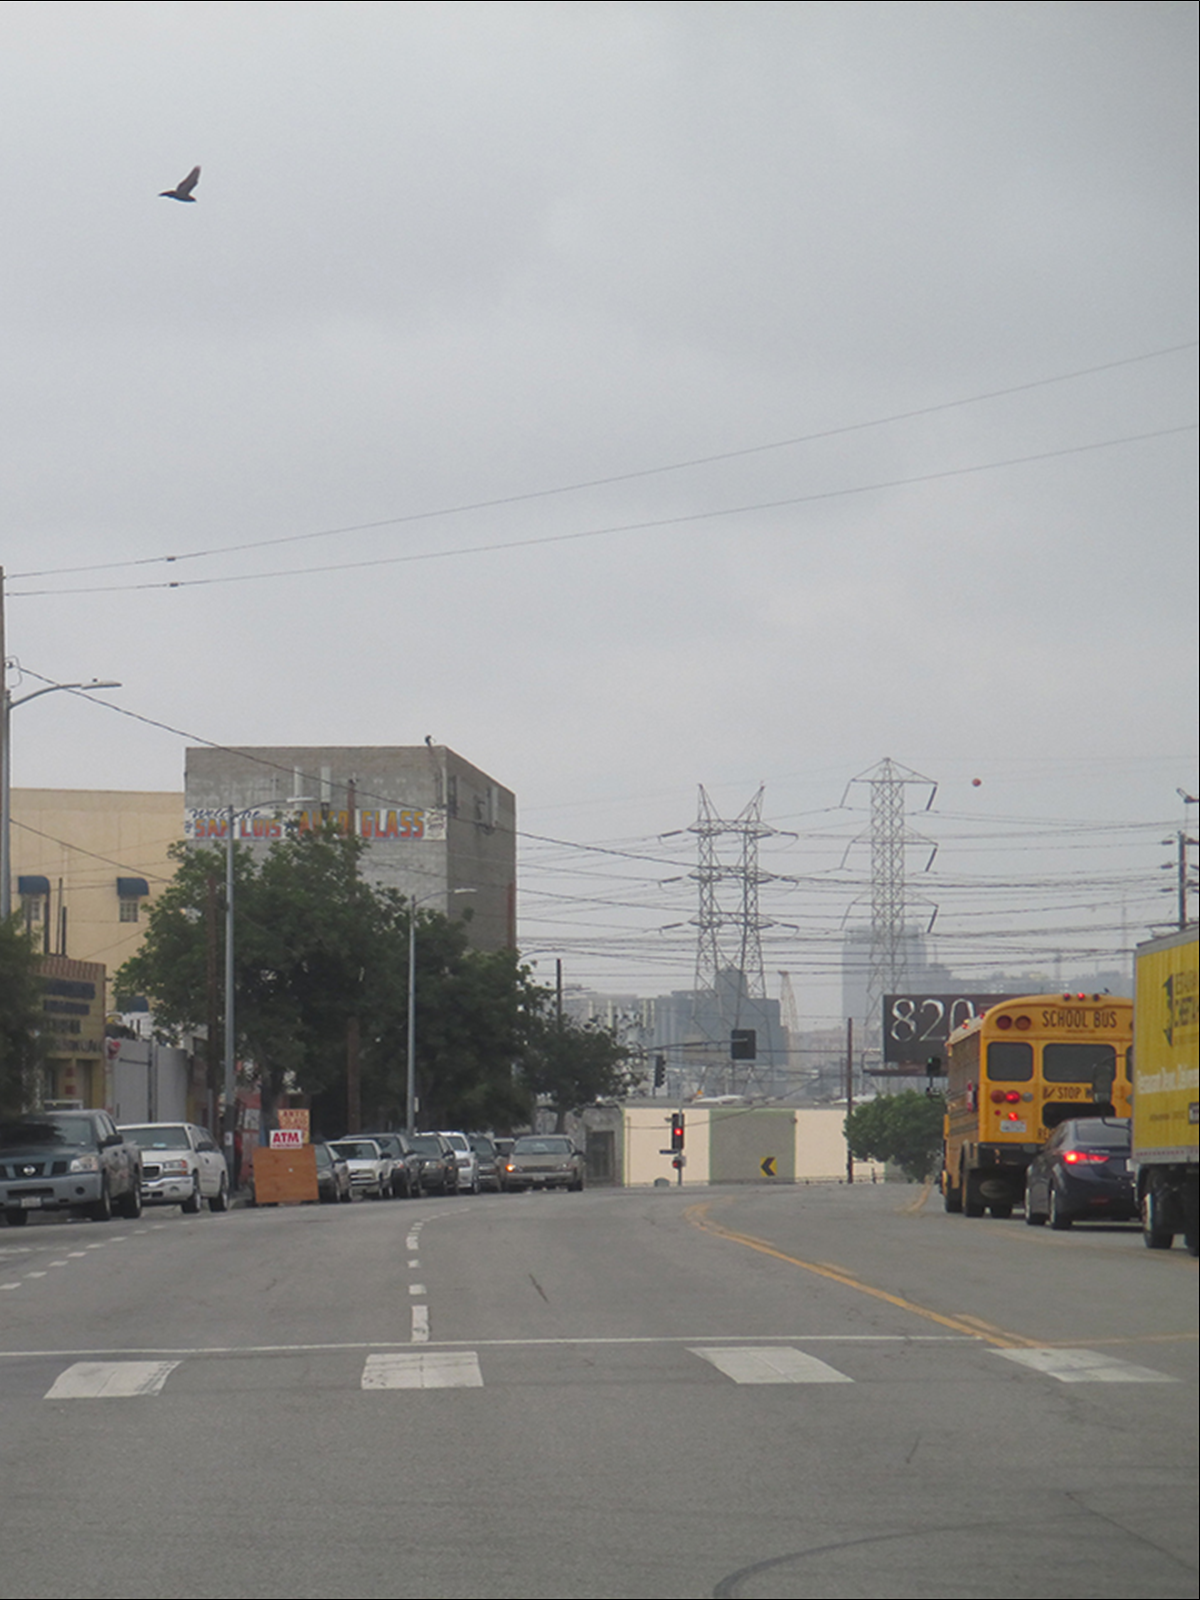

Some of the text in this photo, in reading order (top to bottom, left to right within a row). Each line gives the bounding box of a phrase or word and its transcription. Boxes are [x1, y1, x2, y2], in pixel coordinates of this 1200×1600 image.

[240, 819, 282, 838] LUIS
[360, 810, 425, 838] GLASS
[891, 998, 974, 1041] 820
[1042, 1010, 1117, 1028] SCHOOL BUS
[1057, 1086, 1082, 1099] STOP
[273, 1132, 300, 1143] ATM
